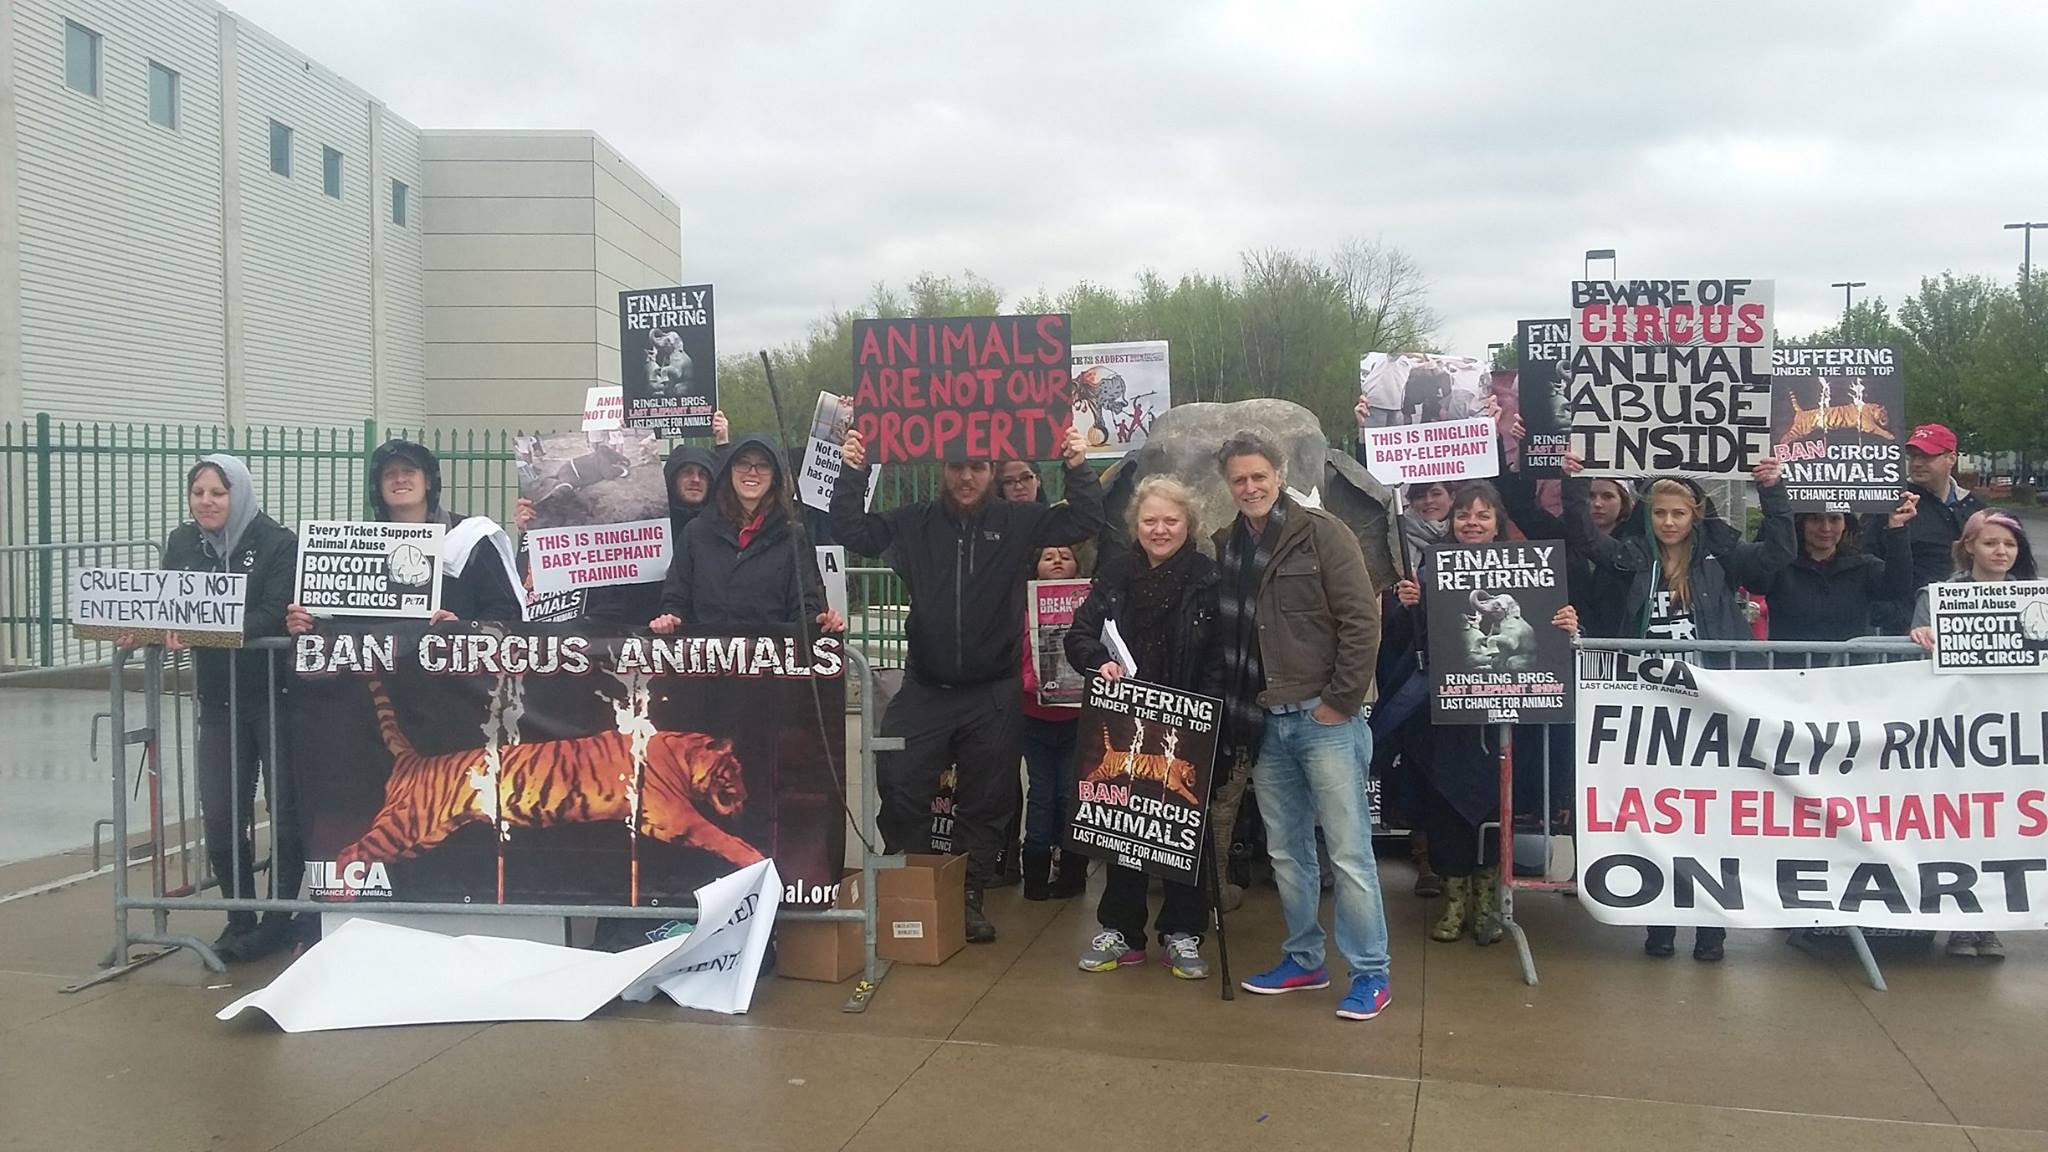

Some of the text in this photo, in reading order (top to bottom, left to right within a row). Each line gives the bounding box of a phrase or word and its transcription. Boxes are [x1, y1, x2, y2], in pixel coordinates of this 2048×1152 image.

[627, 290, 706, 313] FINALLY
[1572, 279, 1751, 308] BEWARE OF
[627, 309, 707, 330] RETIRING
[1582, 303, 1764, 343] CIRCUS
[859, 315, 1064, 367] ANIMALS
[1528, 323, 1571, 343] FIN
[1094, 354, 1129, 364] SADDEST
[1571, 346, 1771, 387] ANIMAL
[1772, 348, 1893, 366] SUFFERING
[1772, 366, 1894, 376] UNDER THE BIG TOP
[856, 367, 1072, 408] ARE NOT OUR
[633, 396, 708, 409] RINGLING BROS.
[1571, 381, 1770, 426] ABUSE
[583, 410, 605, 420] NOT
[630, 416, 711, 428] LAST CHANCE FOR ANIMALS
[858, 408, 1073, 464] PROPERTY
[1371, 423, 1489, 446] THIS IS RINGLING
[814, 441, 832, 456] Not
[1375, 441, 1488, 463] BABY-ELEPHANT
[1571, 425, 1770, 473] INSIDE
[1774, 440, 1901, 462] BAN CIRCUS
[1400, 460, 1465, 478] TRAINING
[1528, 456, 1548, 466] LAST
[806, 466, 822, 480] has
[1781, 463, 1900, 483] ANIMALS
[818, 486, 823, 495] a
[1800, 489, 1836, 500] CHANCE
[1839, 490, 1856, 500] FOR
[1858, 490, 1900, 500] ANIMALS
[308, 524, 432, 539] Every Ticket Supports
[536, 534, 570, 551] THIS
[576, 533, 590, 547] IS
[594, 526, 663, 545] RINGLING
[307, 538, 386, 550] Animal Abuse
[304, 555, 385, 574] BOYCOTT
[542, 544, 662, 570] BABY-ELEPHANT
[1436, 546, 1554, 570] FINALLY
[304, 573, 388, 592] RINGLING
[568, 564, 638, 584] TRAINING
[1438, 568, 1555, 591] RETIRING
[80, 570, 168, 600] CRUELTY
[205, 574, 243, 597] NOT
[1938, 586, 1970, 598] Every
[1972, 586, 2007, 596] Ticket
[302, 591, 398, 607] BROS. CIRCUS
[1940, 599, 2016, 610] Animal Abuse
[1940, 616, 2018, 634] BOYCOTT
[1940, 634, 2023, 650] RINGLING
[296, 633, 845, 678] BAN CIRCUS ANIMALS
[1941, 651, 1983, 665] BROS.
[1985, 650, 2034, 664] CIRCUS
[1446, 672, 1558, 686] RINGLING BROS.
[1616, 653, 1698, 690] LCA
[1091, 676, 1214, 722] SUFFERING
[1440, 683, 1564, 695] LAST ELEPHANT SHOW
[1580, 682, 1699, 698] LAST CHANCE FOR ANIMALS
[1441, 696, 1563, 710] LAST CHANCE FOR ANIMALS
[1090, 696, 1212, 733] UNDER THE BIG TOP
[1498, 709, 1519, 718] LCA
[1588, 704, 1860, 776] FINALLY!
[1078, 780, 1201, 828] BAN CIRCUS
[1586, 786, 1717, 835] LAST
[1730, 790, 2005, 842] ELEPHANT
[1076, 801, 1196, 851] ANIMALS
[1074, 828, 1096, 844] LAST
[1096, 832, 1133, 856] CHANCE
[1133, 844, 1150, 860] FOR
[1151, 850, 1193, 871] ANIMALS
[1126, 856, 1142, 867] LCA
[326, 861, 392, 890] LCA
[1584, 854, 1745, 911] ON
